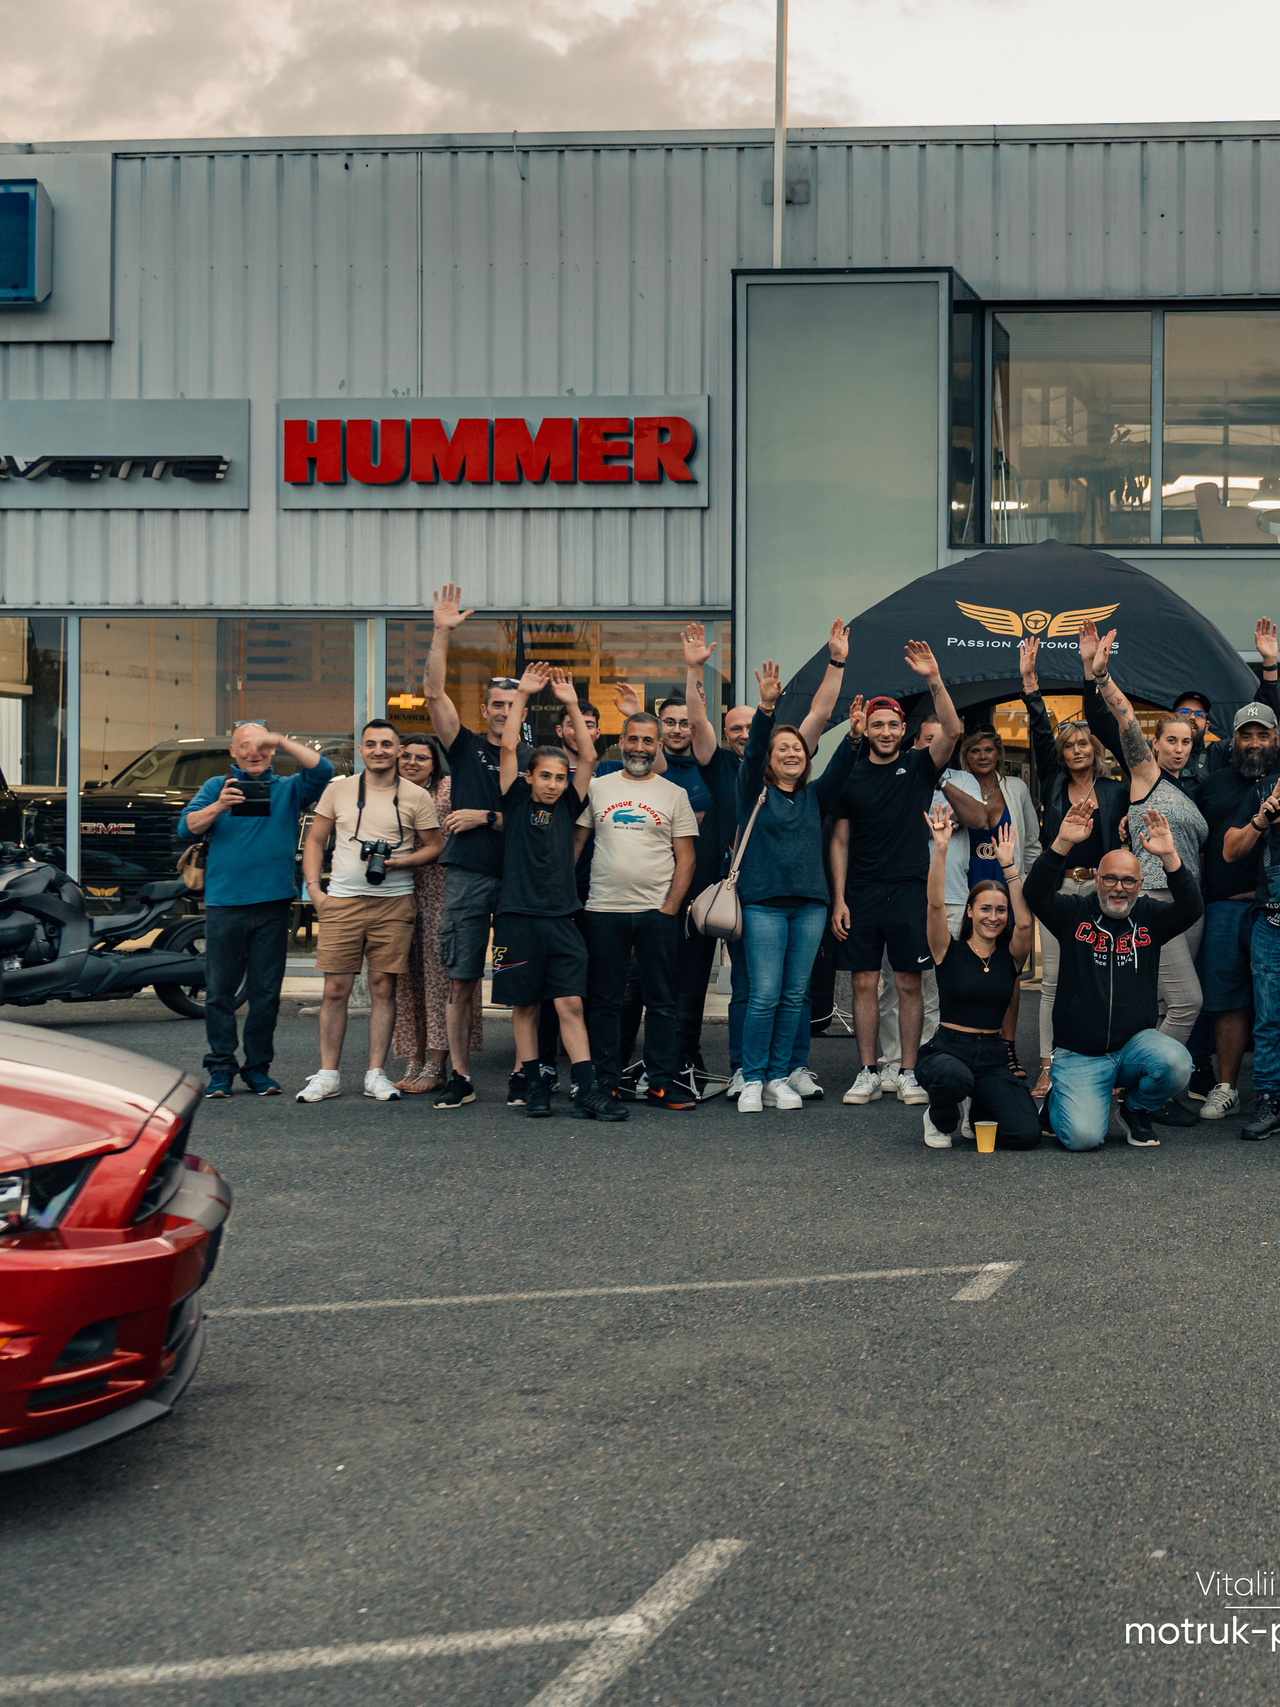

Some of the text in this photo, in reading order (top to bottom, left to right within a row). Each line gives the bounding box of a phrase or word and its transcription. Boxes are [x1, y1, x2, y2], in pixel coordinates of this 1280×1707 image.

[284, 416, 697, 485] HUMMER
[946, 637, 1012, 648] PASSION
[600, 800, 662, 826] CLASSIQUE LACOSTE
[79, 822, 136, 835] GMC
